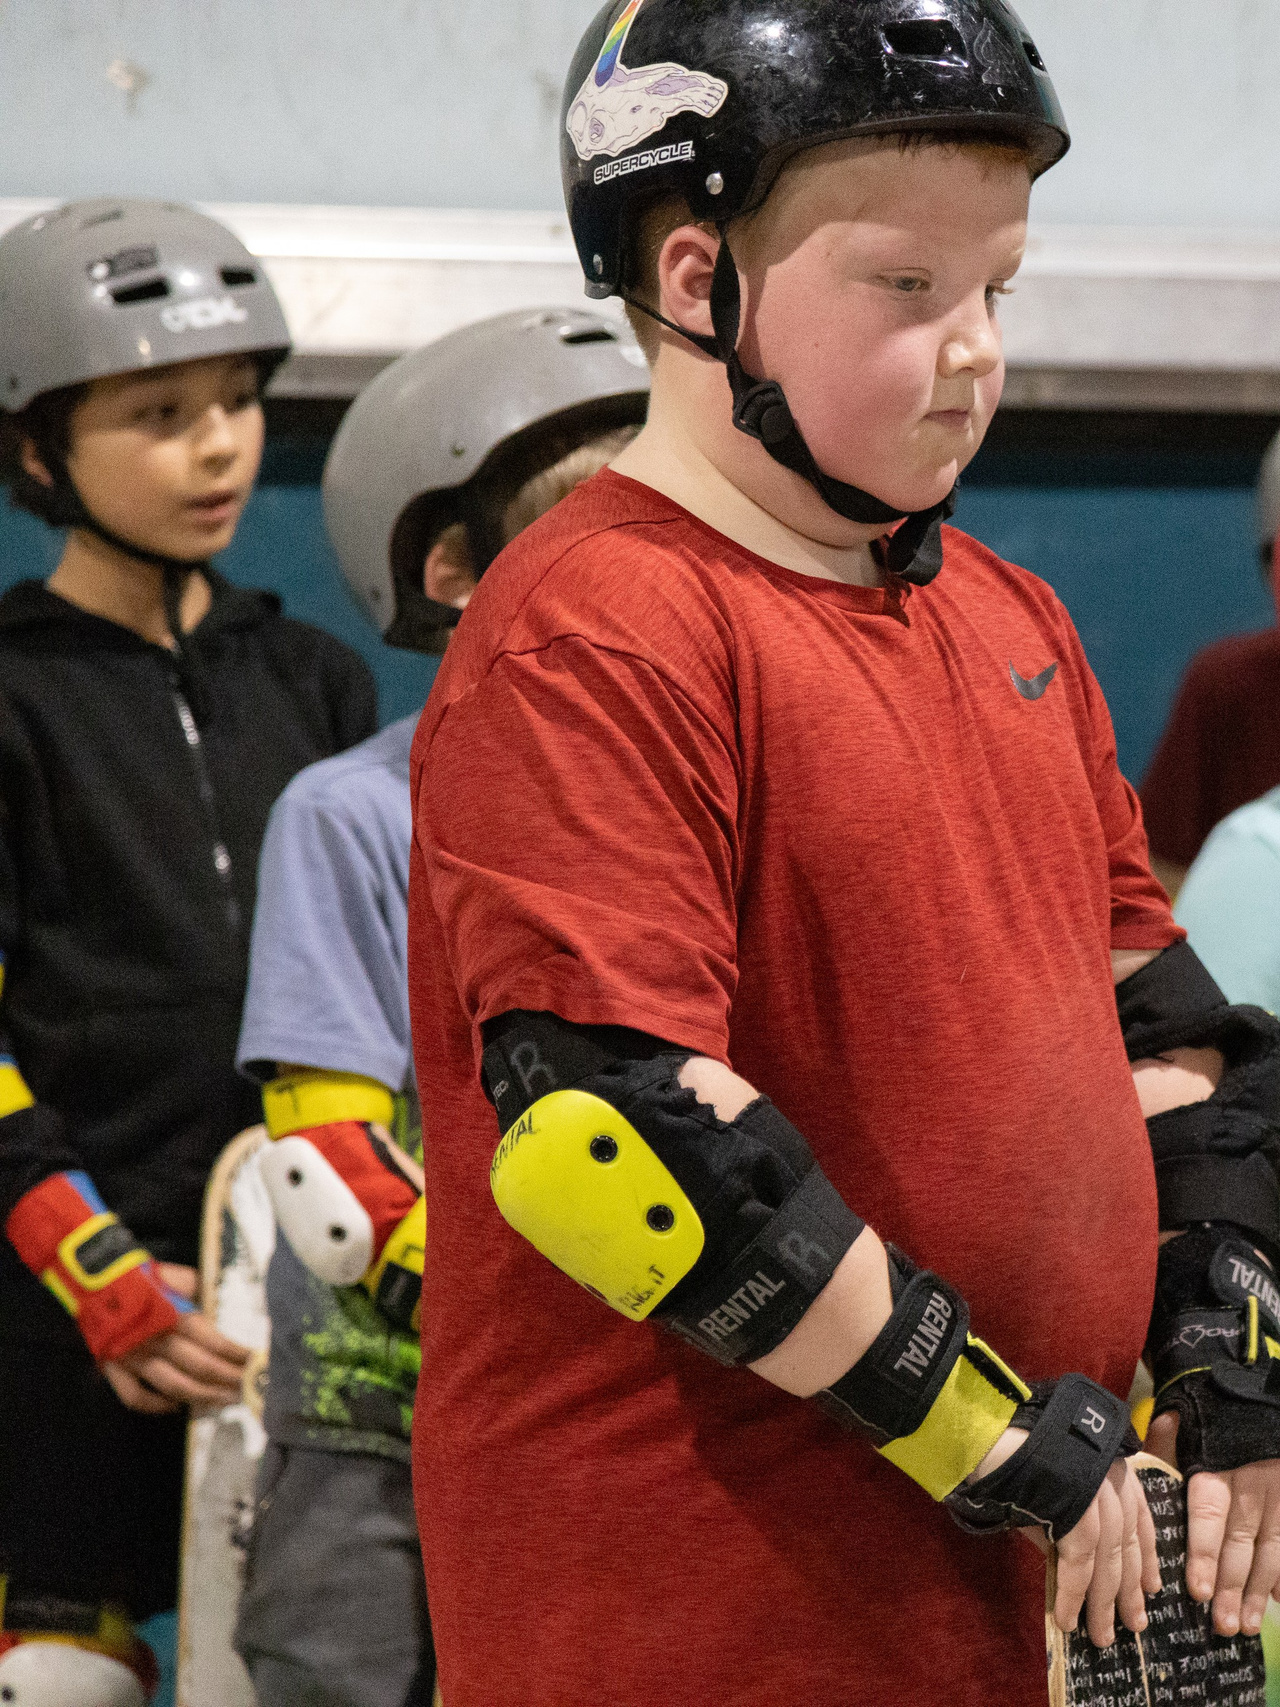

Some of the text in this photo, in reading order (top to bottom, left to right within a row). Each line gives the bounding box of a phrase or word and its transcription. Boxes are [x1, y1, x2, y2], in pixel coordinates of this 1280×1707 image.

[594, 141, 693, 184] SUPERCYCLE
[698, 1271, 787, 1340] RENTAL
[893, 1291, 953, 1378] RENTAL
[1080, 1406, 1106, 1434] R
